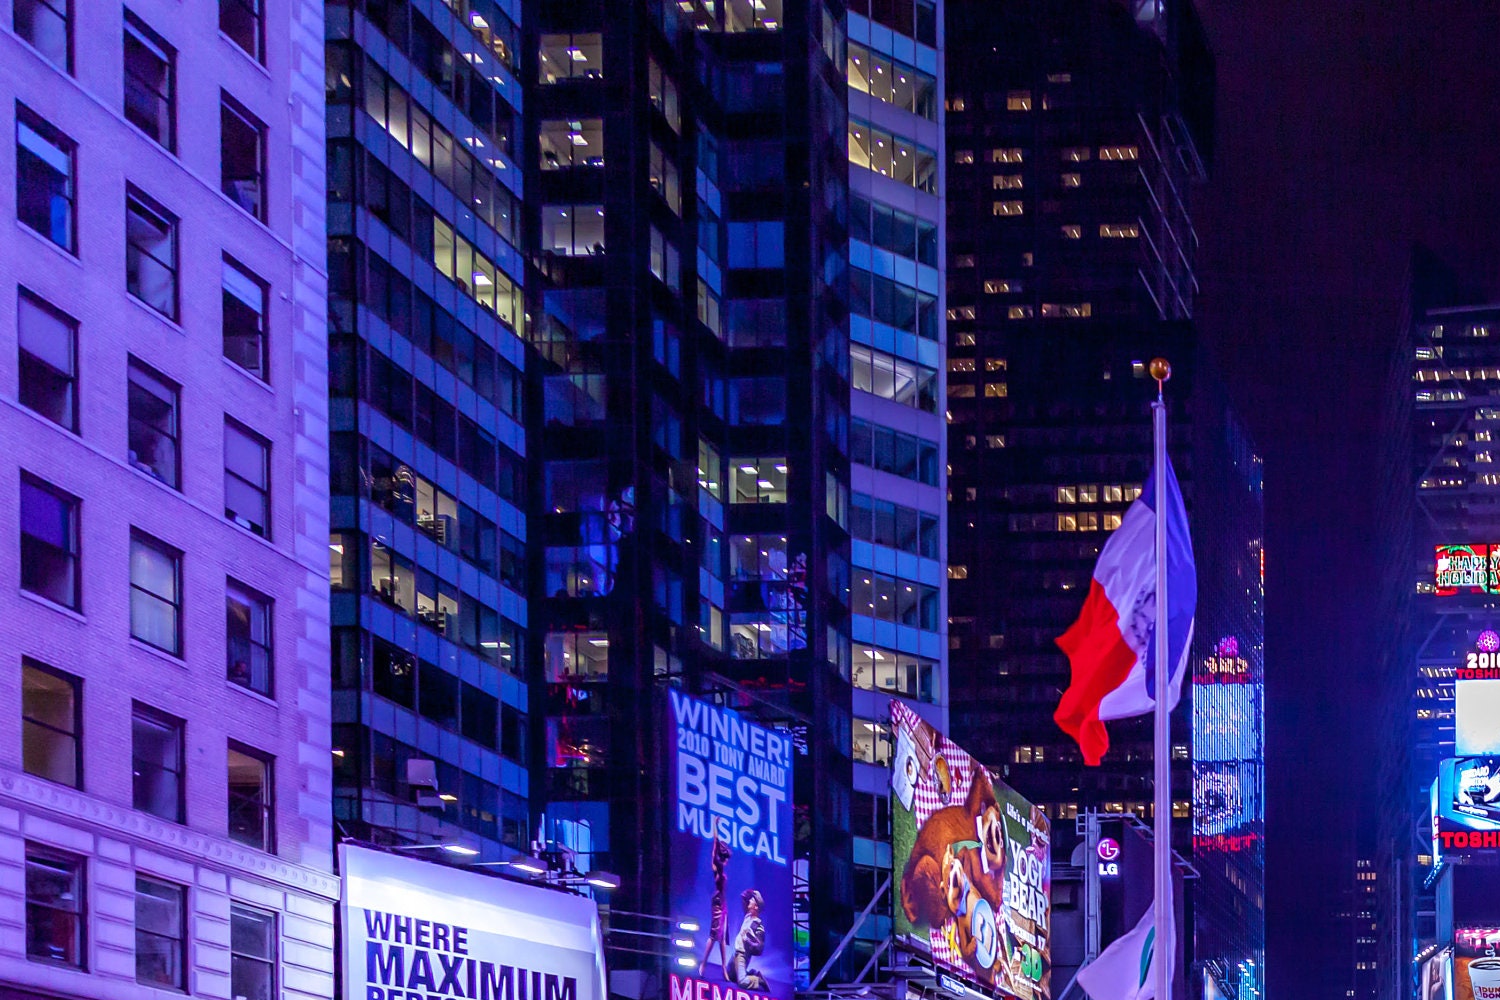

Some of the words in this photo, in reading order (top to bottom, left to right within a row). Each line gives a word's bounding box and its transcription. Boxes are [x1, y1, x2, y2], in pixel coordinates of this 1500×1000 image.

[1449, 556, 1500, 571] HAPPY
[671, 691, 789, 768] WINNER!
[677, 727, 709, 759] 2010
[714, 740, 744, 772] TONY
[748, 755, 786, 788] AWARD
[677, 752, 786, 834] BEST
[679, 803, 786, 865] MUSICAL
[1009, 838, 1043, 894] YOGI
[1099, 864, 1118, 876] LG
[1009, 872, 1047, 931] BEAR
[364, 908, 468, 955] WHERE
[1021, 943, 1042, 983] 3D
